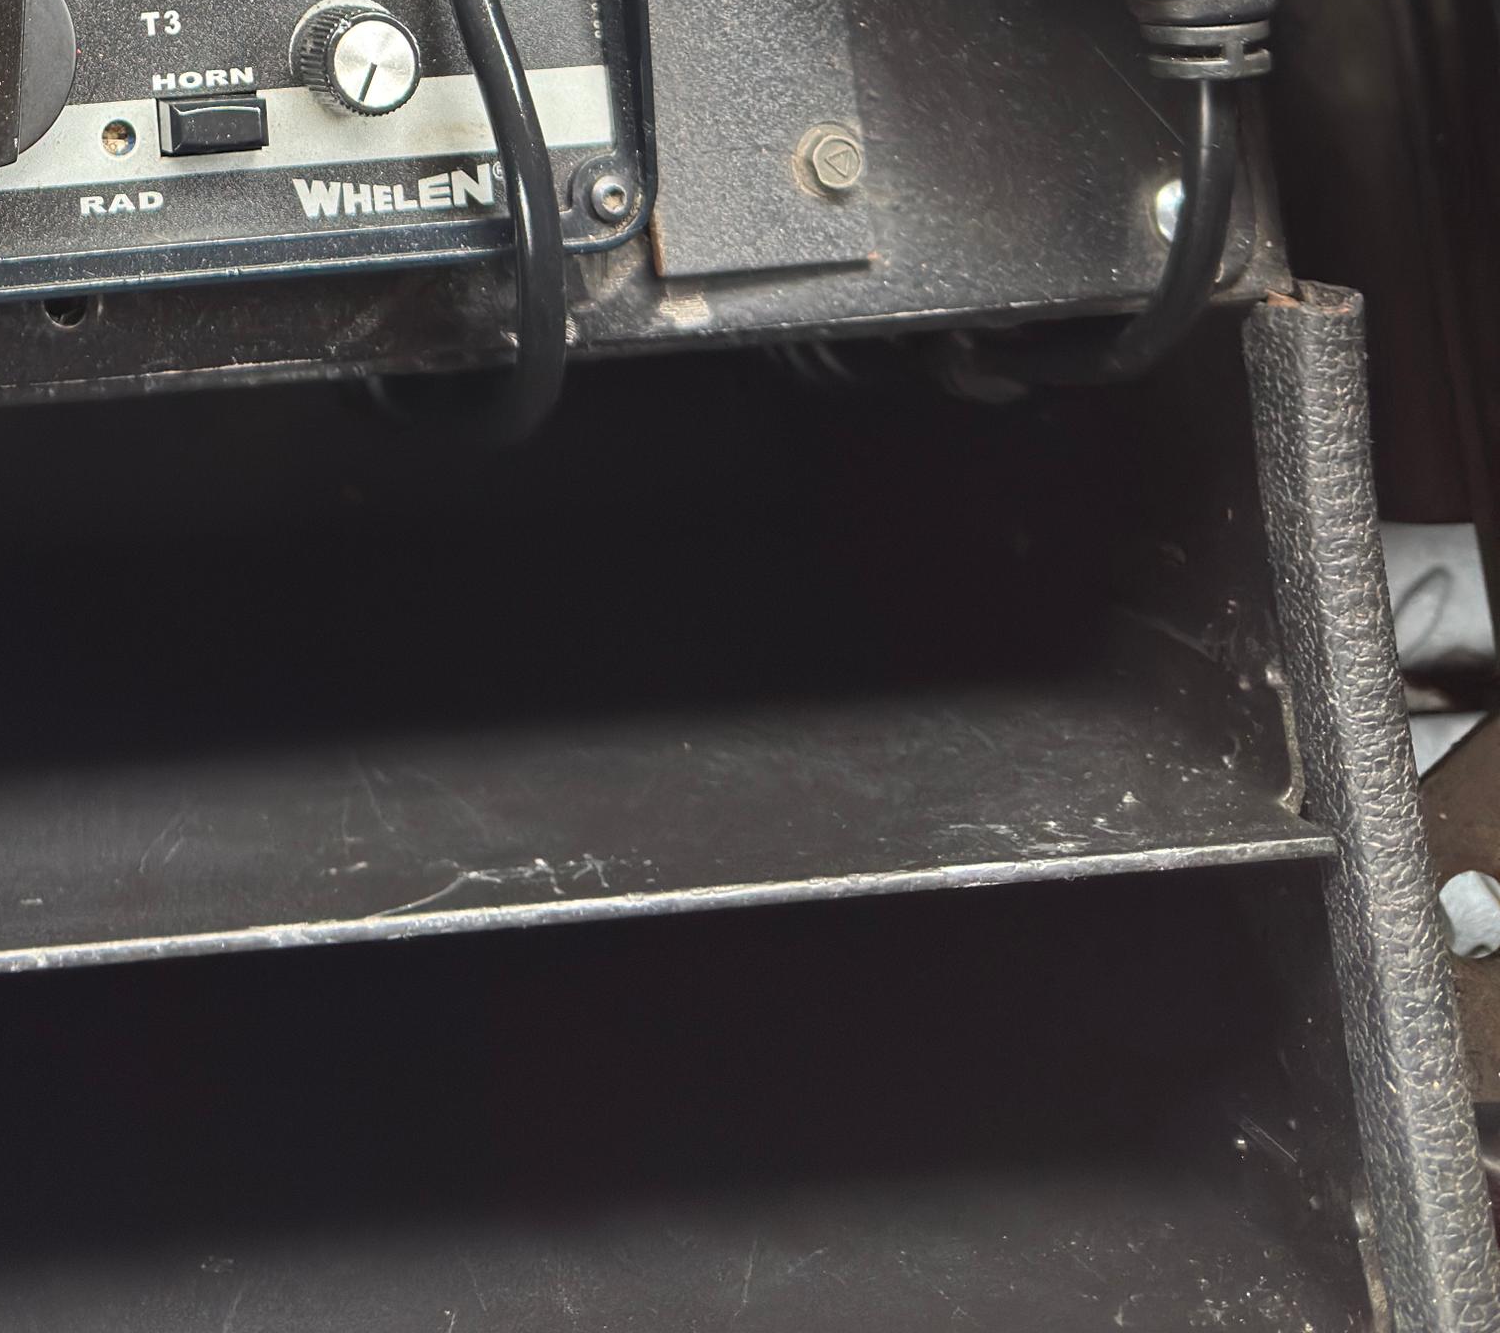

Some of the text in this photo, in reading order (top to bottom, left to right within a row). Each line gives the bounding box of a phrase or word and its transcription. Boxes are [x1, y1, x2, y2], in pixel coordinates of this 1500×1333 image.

[140, 10, 183, 36] T3
[152, 66, 255, 92] HORN
[79, 190, 165, 216] RAD
